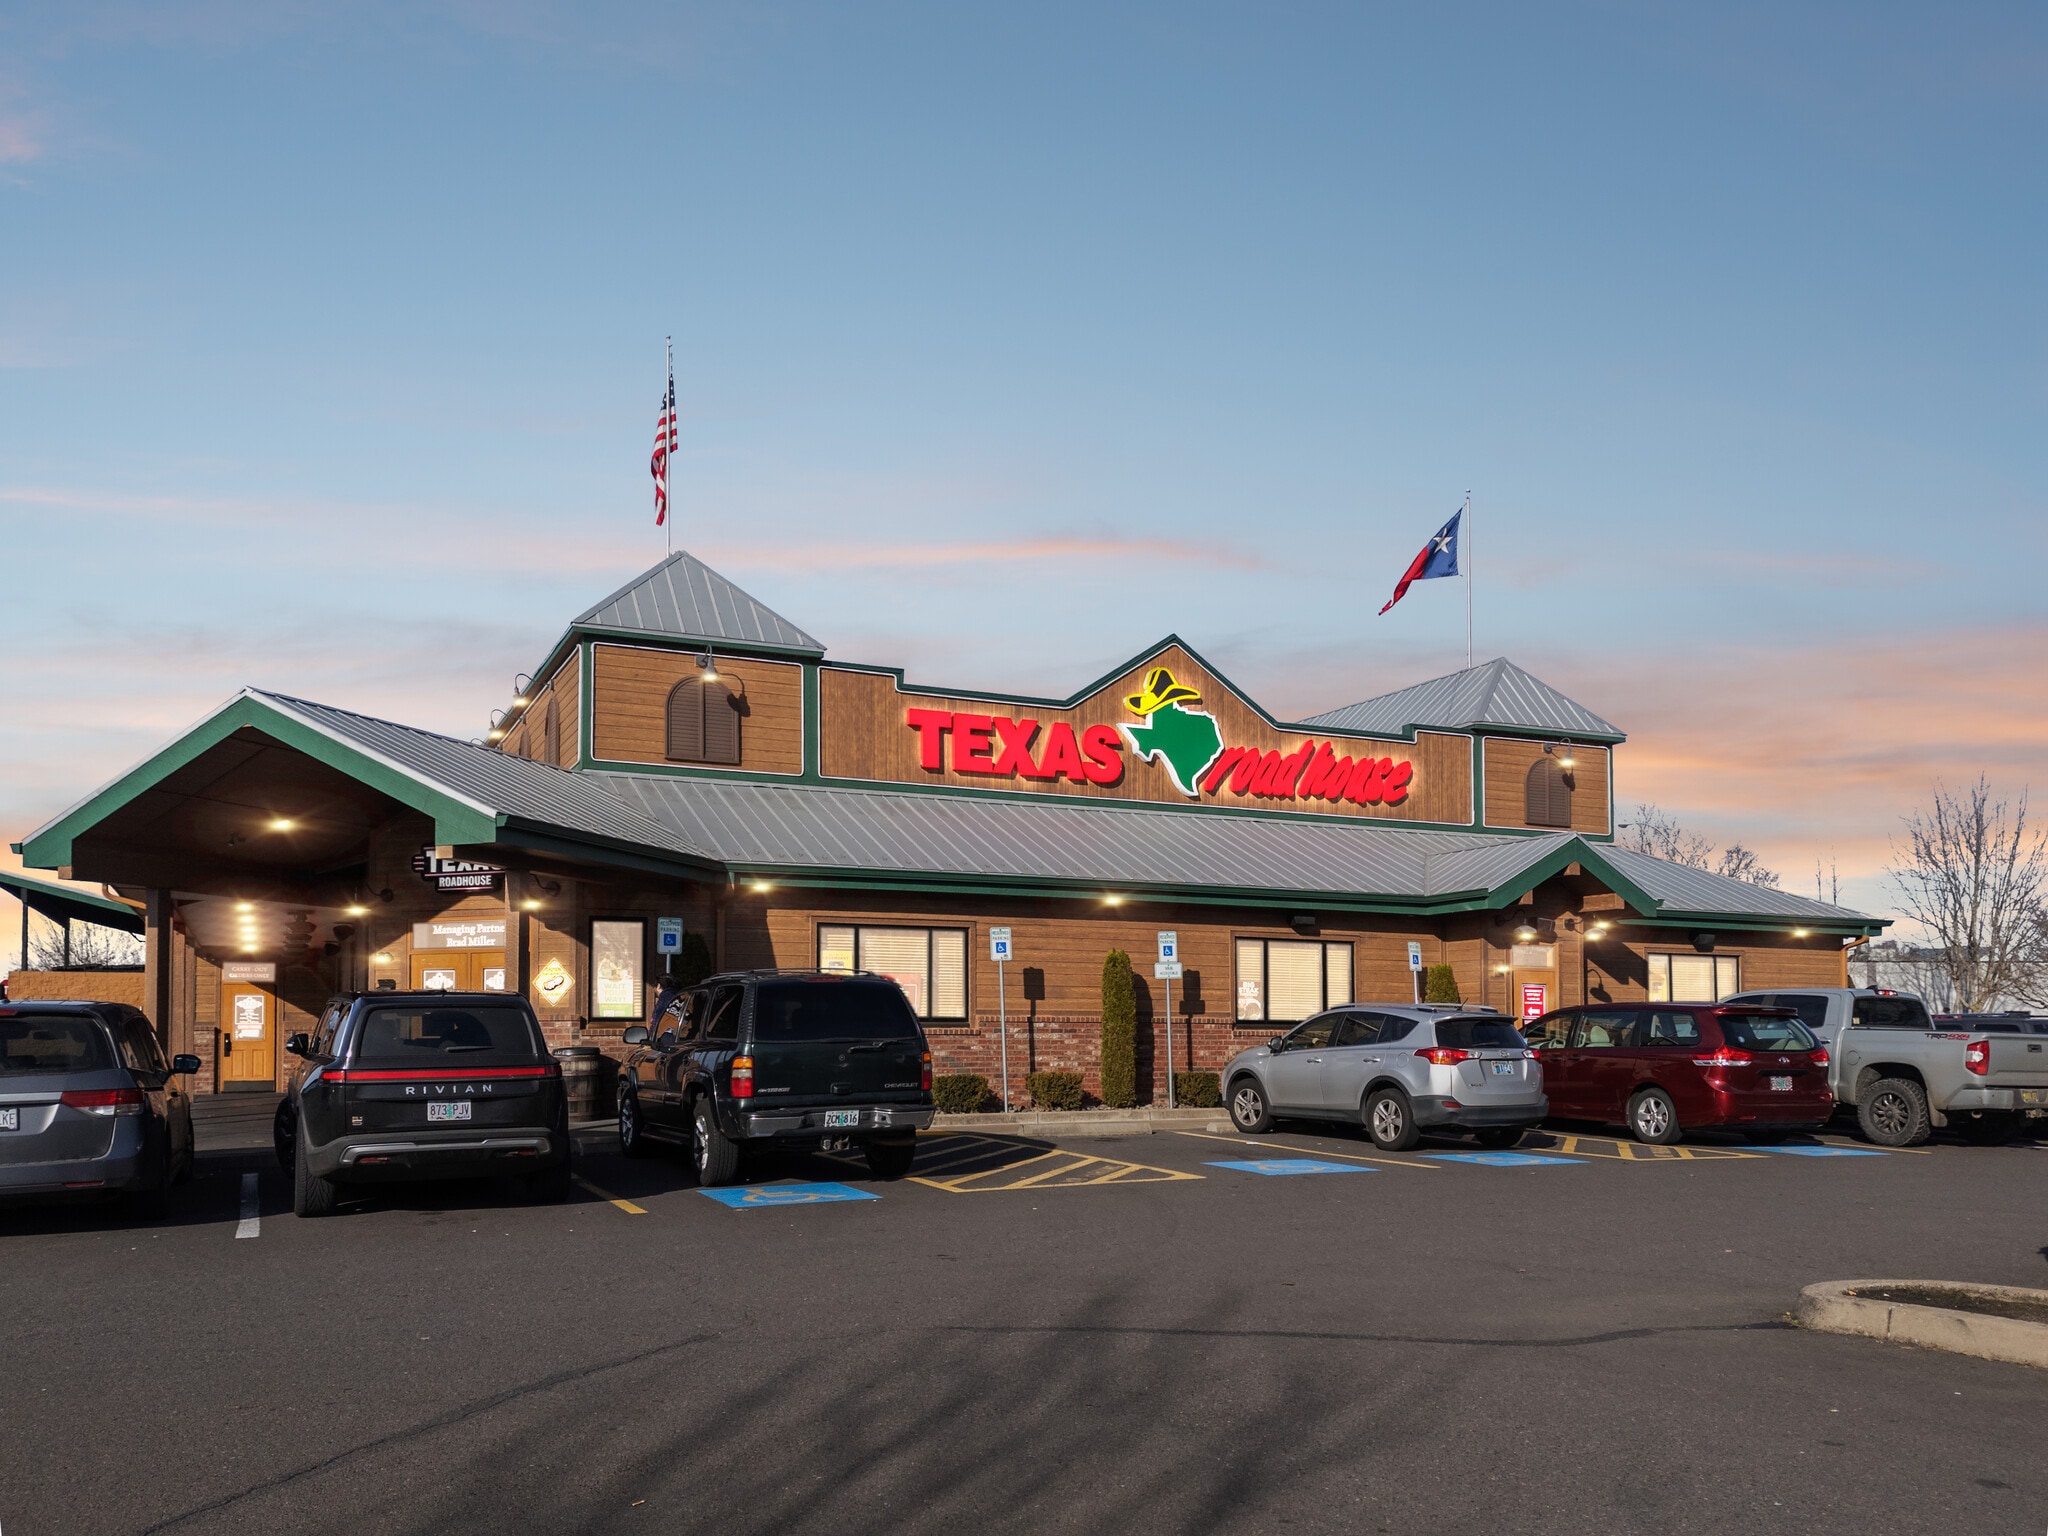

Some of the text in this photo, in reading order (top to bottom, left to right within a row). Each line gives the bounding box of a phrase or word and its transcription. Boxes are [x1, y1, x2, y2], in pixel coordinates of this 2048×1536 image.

[907, 708, 1123, 784] TEXAS
[438, 875, 492, 888] ROADHOUSE
[432, 923, 505, 936] Managing Partne
[446, 935, 496, 947] Brad Miller
[405, 1084, 492, 1095] RIVIAN
[430, 1103, 470, 1116] 873 PJV
[0, 1113, 16, 1126] KE
[826, 1112, 858, 1124] ZCM 816
